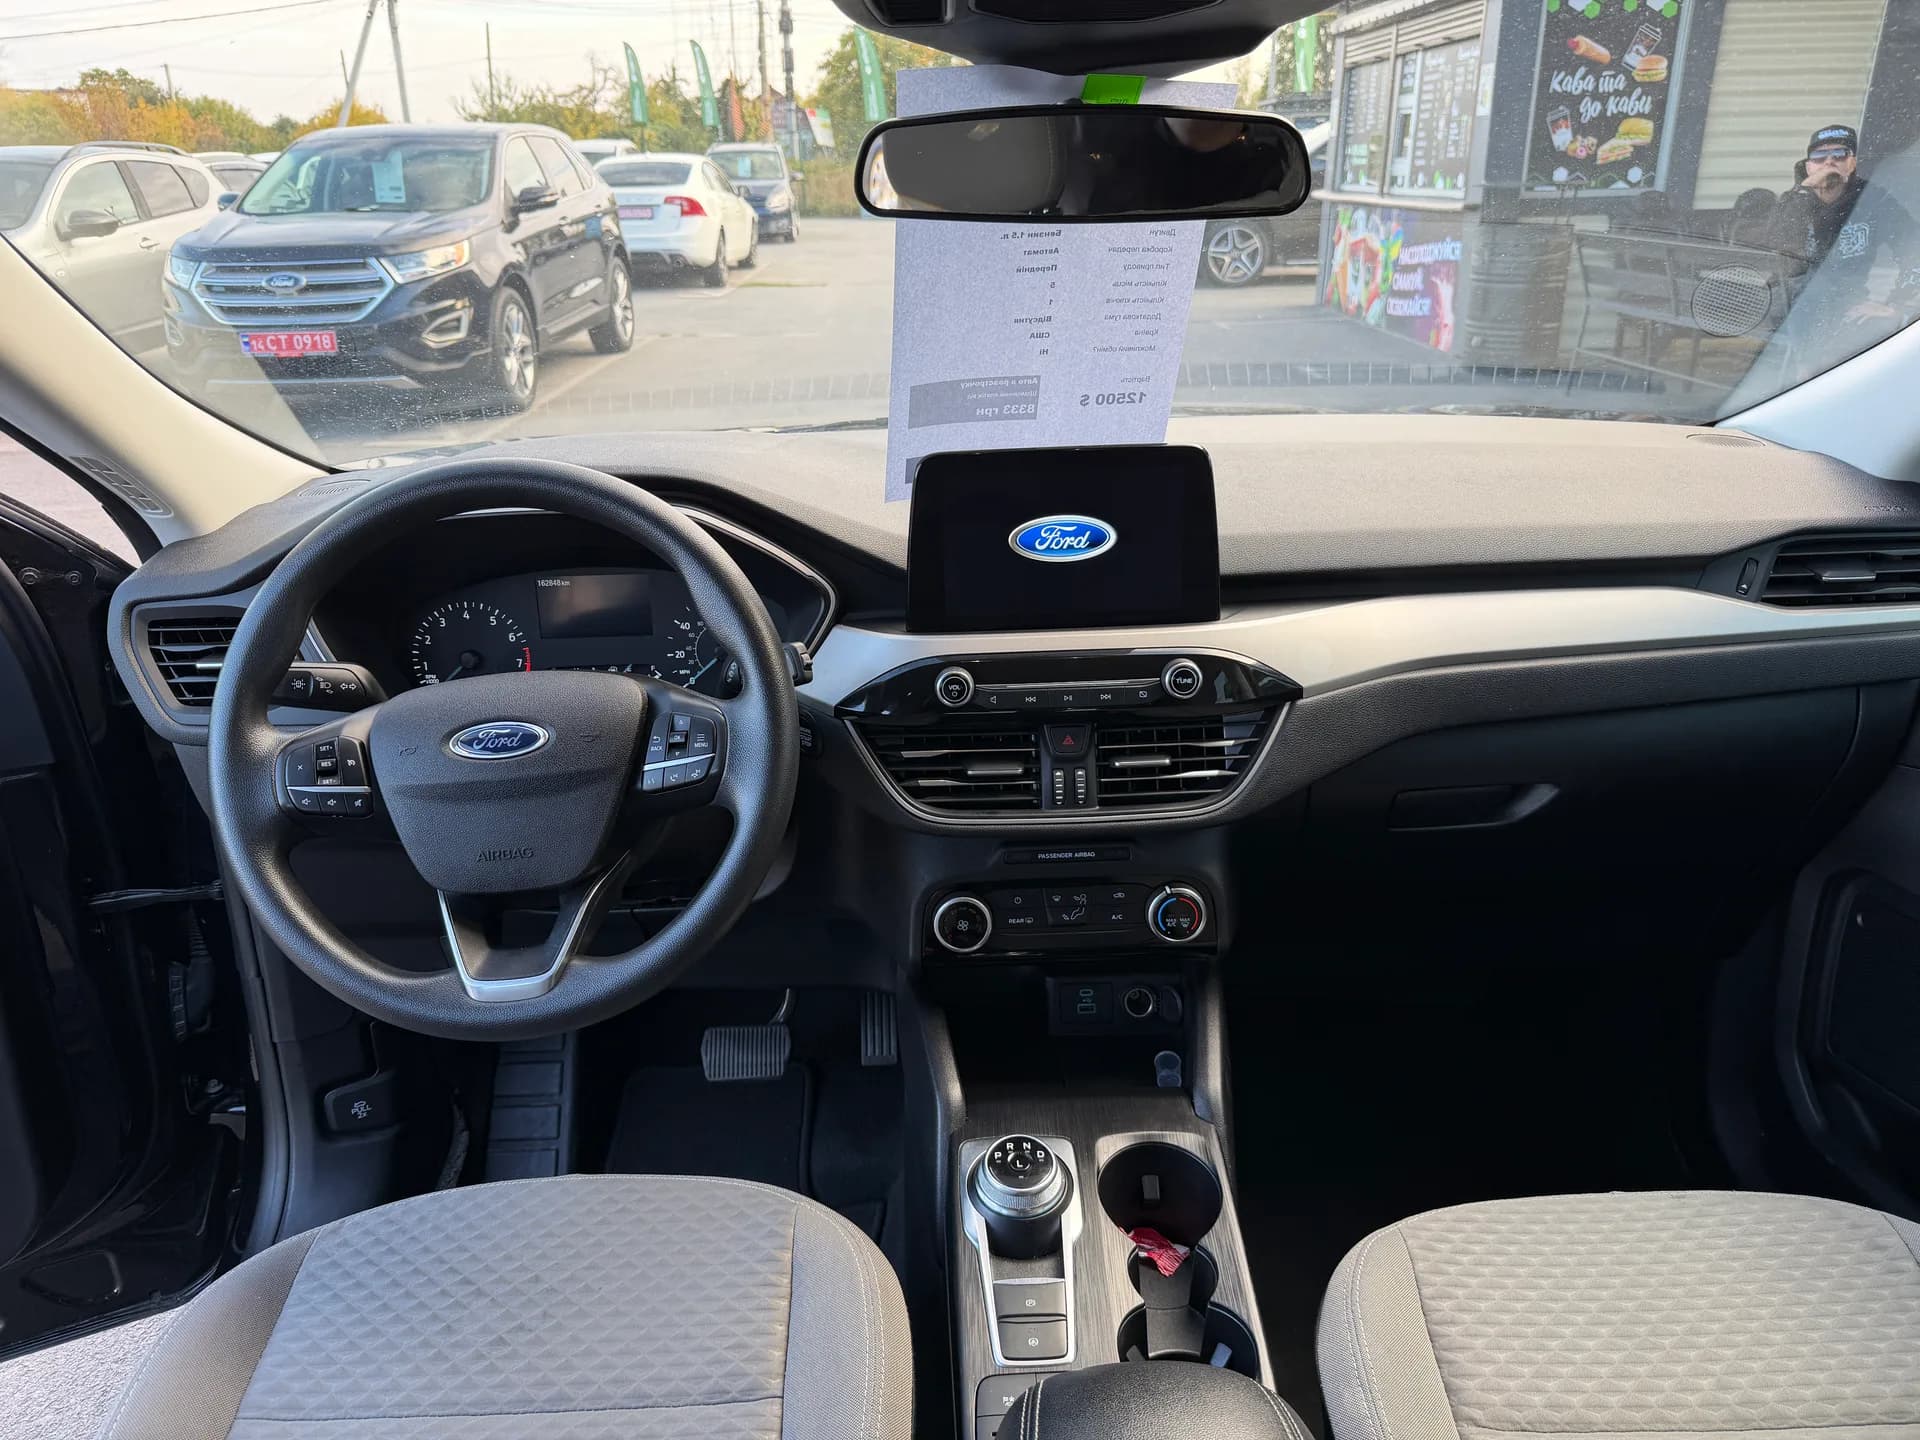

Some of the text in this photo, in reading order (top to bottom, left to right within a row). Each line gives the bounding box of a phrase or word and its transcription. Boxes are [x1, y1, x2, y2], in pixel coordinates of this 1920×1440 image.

[1580, 87, 1652, 123] до кави
[293, 333, 332, 349] 0918
[1035, 525, 1091, 550] Ford
[463, 610, 470, 620] 4
[440, 618, 446, 627] 3
[490, 616, 496, 626] 5
[680, 622, 690, 630] 40
[424, 635, 431, 645] 2
[508, 632, 516, 642] 6
[423, 661, 428, 671] 1
[516, 659, 522, 668] 7
[1176, 677, 1193, 685] TUNE
[473, 729, 522, 750] Ford
[476, 847, 534, 863] AIRBAG
[1038, 852, 1073, 860] PASSENGER
[1006, 1142, 1014, 1150] R
[1023, 1142, 1031, 1150] N
[994, 1151, 1002, 1159] P
[1036, 1150, 1045, 1158] D
[1016, 1160, 1023, 1168] L
